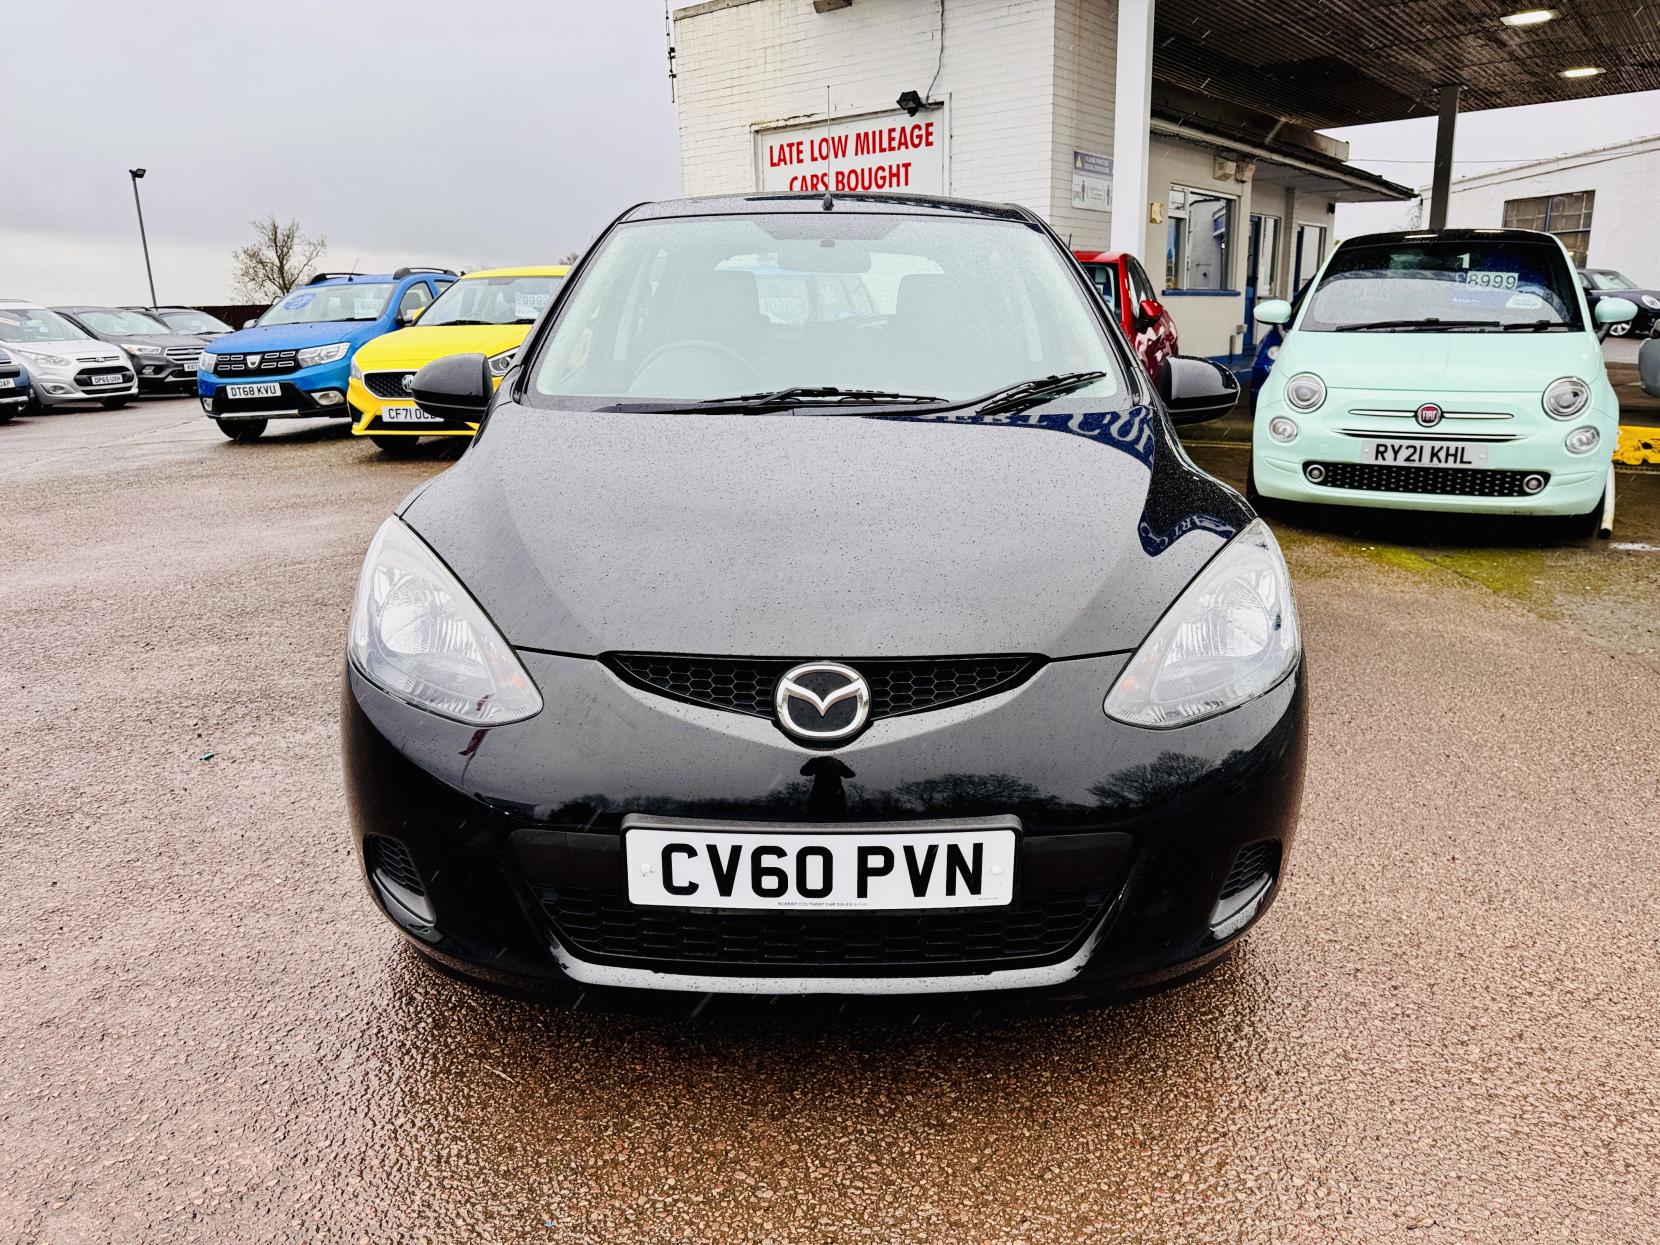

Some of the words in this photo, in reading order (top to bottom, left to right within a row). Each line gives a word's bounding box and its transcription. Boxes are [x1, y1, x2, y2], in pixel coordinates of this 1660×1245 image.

[769, 141, 804, 167] LATE
[810, 134, 849, 162] LOW
[854, 122, 934, 156] MILEAGE
[789, 172, 829, 191] CARS
[835, 162, 912, 192] BOUGHT
[231, 386, 255, 397] DT68
[257, 385, 277, 396] KVU
[388, 408, 412, 419] CF71
[415, 408, 437, 419] OC
[1422, 410, 1437, 421] FIAT
[1374, 443, 1424, 462] RY21
[1430, 445, 1473, 464] KHL
[661, 843, 834, 898] CV60
[857, 842, 984, 899] PVN
